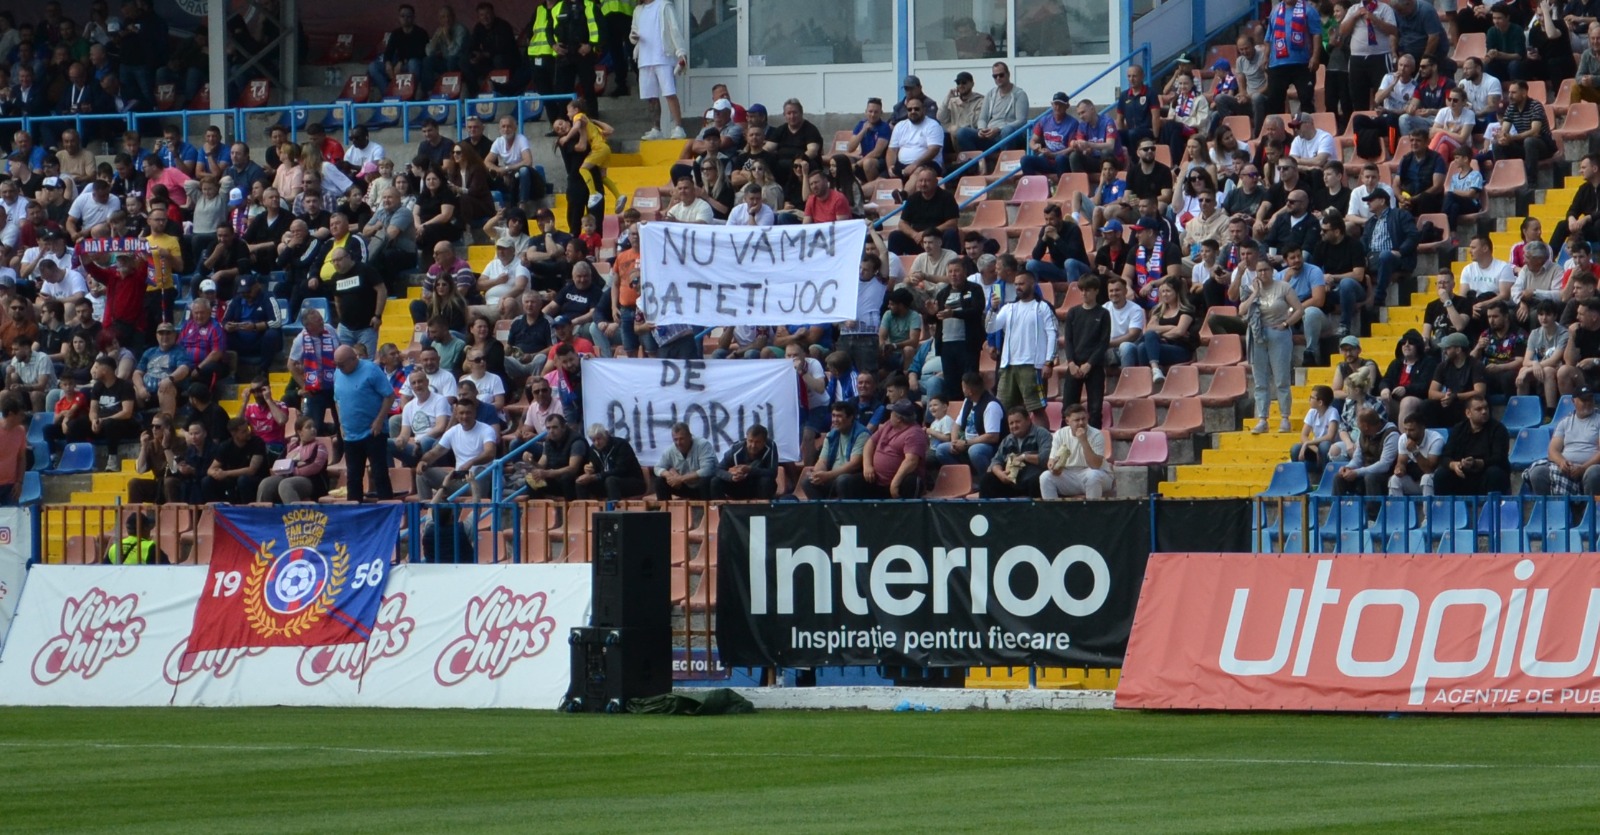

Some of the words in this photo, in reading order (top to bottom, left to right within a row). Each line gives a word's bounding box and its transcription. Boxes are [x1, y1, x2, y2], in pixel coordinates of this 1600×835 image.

[662, 227, 716, 265] NU
[778, 279, 839, 314] JOC
[660, 359, 707, 391] DE
[285, 523, 302, 541] FAN
[212, 570, 242, 598] 19
[350, 558, 385, 589] 58
[61, 586, 139, 637] Viva
[465, 585, 548, 637] Viva
[31, 616, 146, 686] Chips
[433, 616, 556, 687] Chips
[791, 625, 897, 654] Inspirație
[904, 627, 982, 654] pentru
[988, 625, 1070, 650] fiecare
[1219, 559, 1600, 705] utopiu
[1525, 688, 1554, 704] DE
